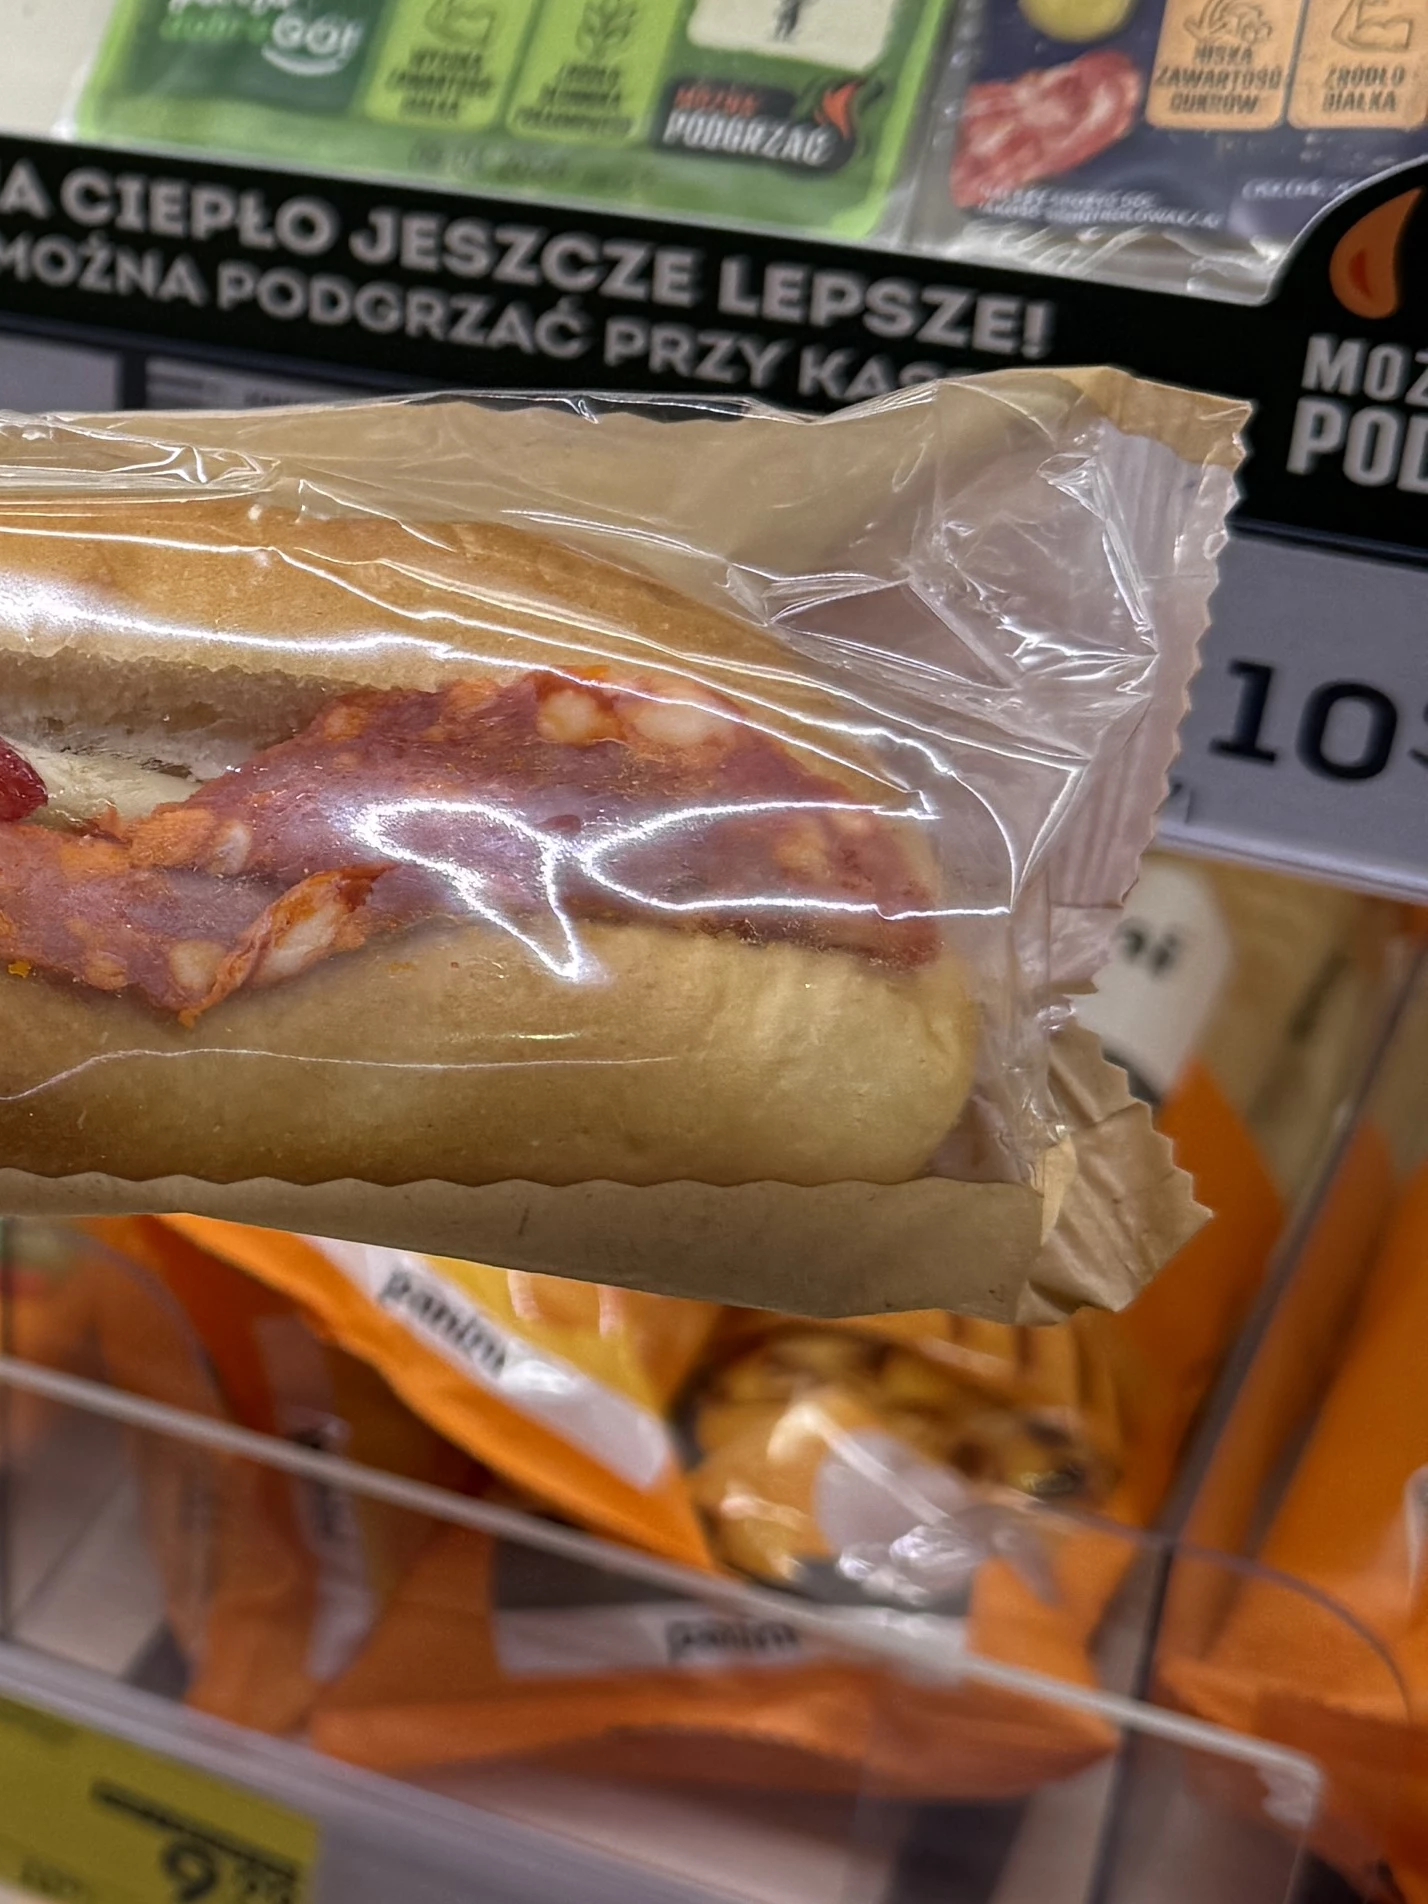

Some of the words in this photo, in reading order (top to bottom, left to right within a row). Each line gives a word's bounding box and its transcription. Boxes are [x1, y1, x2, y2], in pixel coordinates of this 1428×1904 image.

[60, 166, 338, 260] CIEPŁO
[348, 206, 696, 308] JESZCZE
[720, 258, 1052, 360] LEPSZE!
[214, 260, 590, 362] PODGRZAĆ
[602, 318, 796, 392] PRZY
